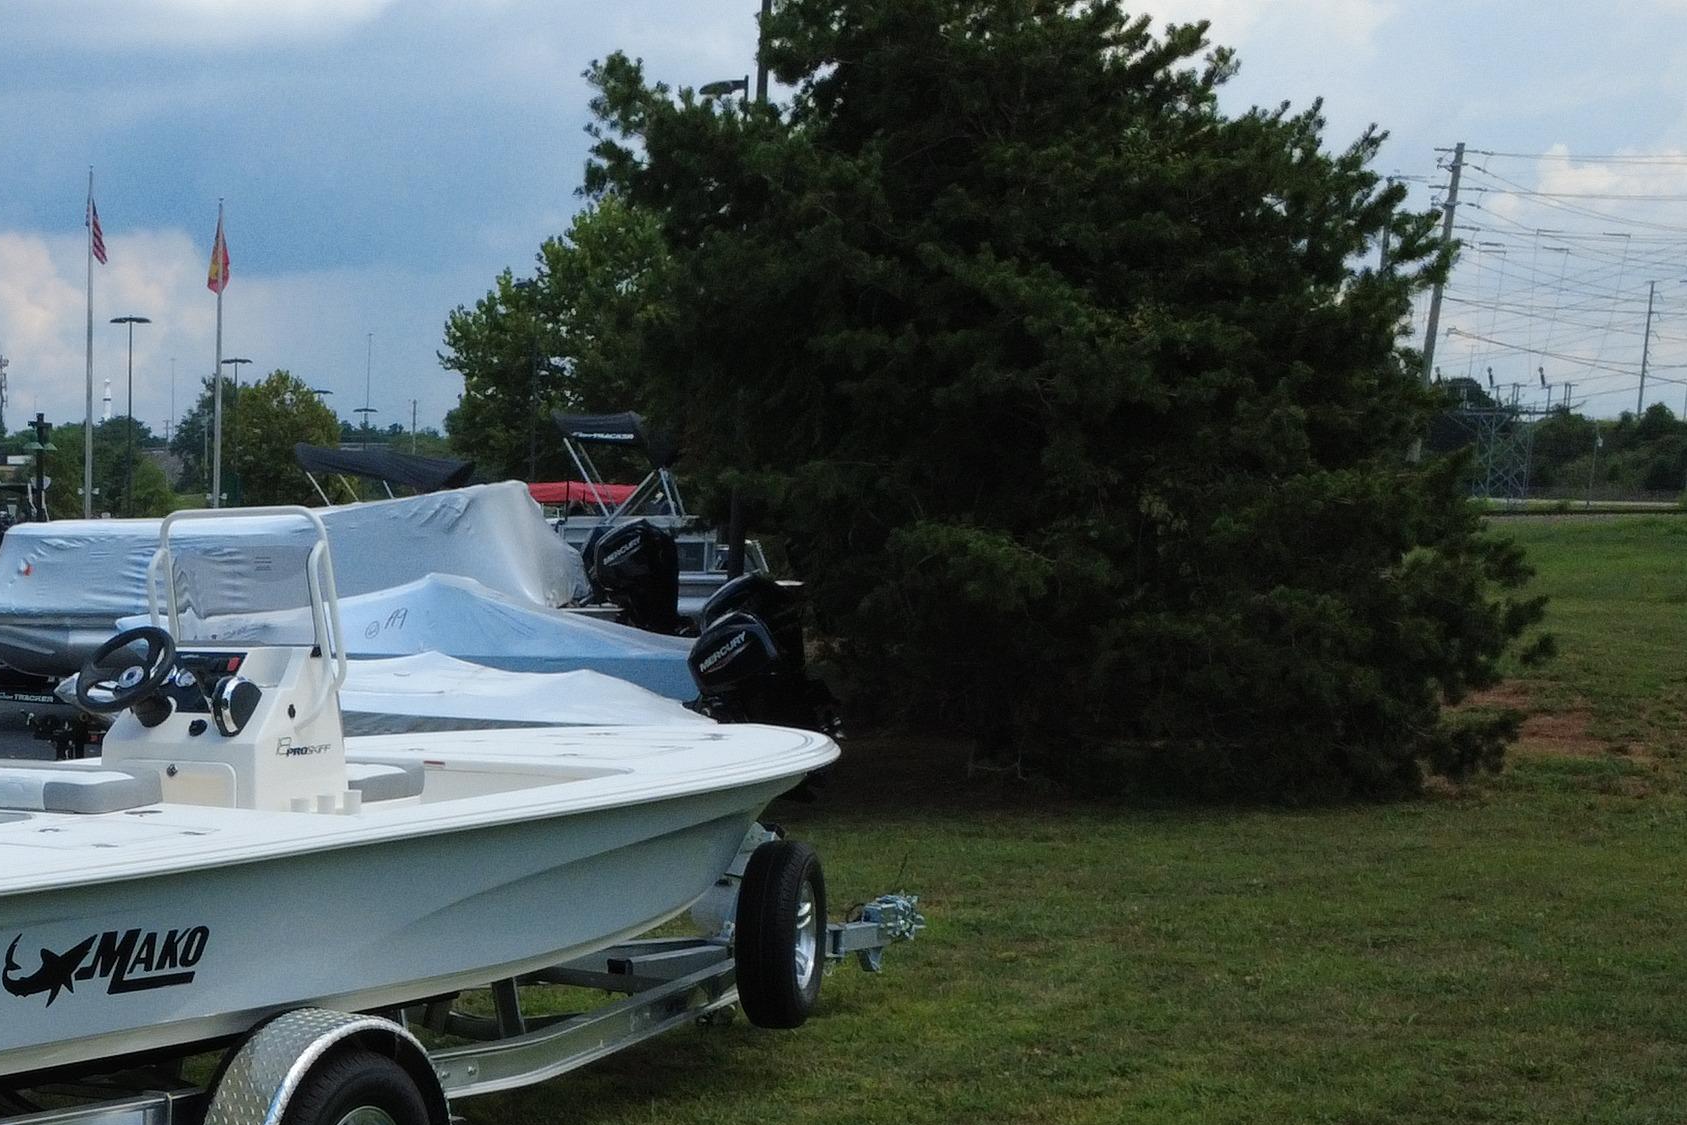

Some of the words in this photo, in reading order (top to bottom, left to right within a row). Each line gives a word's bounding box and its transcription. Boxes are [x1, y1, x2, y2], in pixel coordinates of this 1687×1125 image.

[603, 536, 641, 566] MERCURY
[699, 630, 747, 673] MERCURY
[74, 925, 210, 995] MAKO
